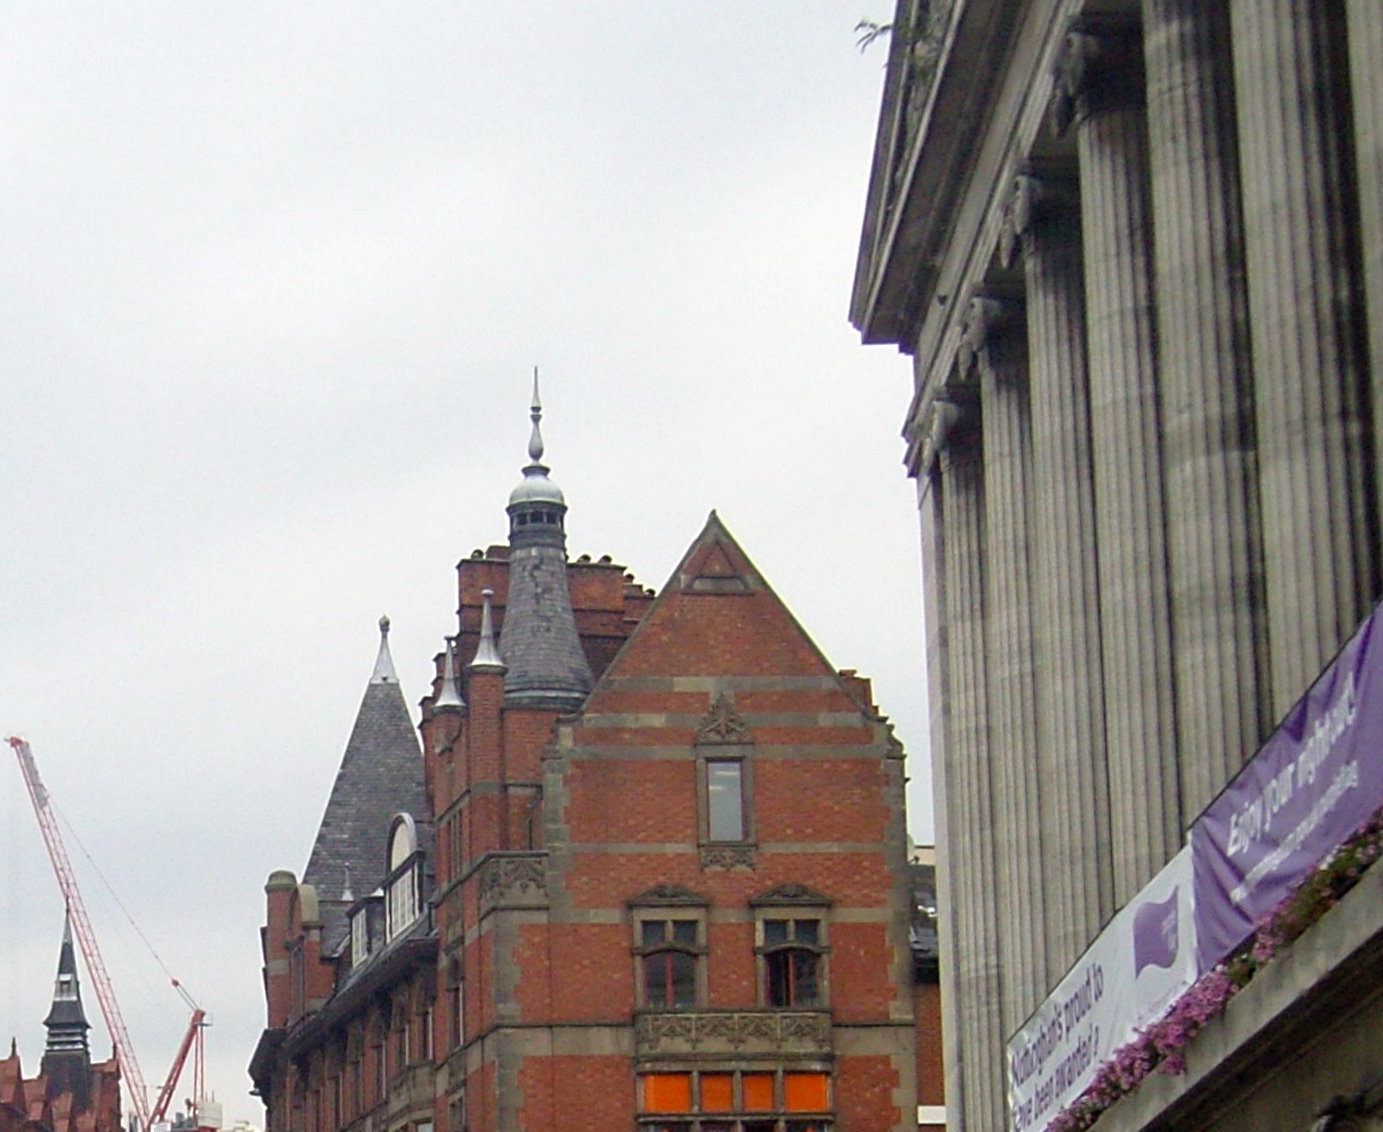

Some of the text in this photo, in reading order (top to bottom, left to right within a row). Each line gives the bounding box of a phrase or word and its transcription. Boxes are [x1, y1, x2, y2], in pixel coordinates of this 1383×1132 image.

[1227, 800, 1263, 857] Enjoy
[1263, 762, 1296, 832] your
[1064, 966, 1092, 1044] proud
[1092, 962, 1105, 1003] to
